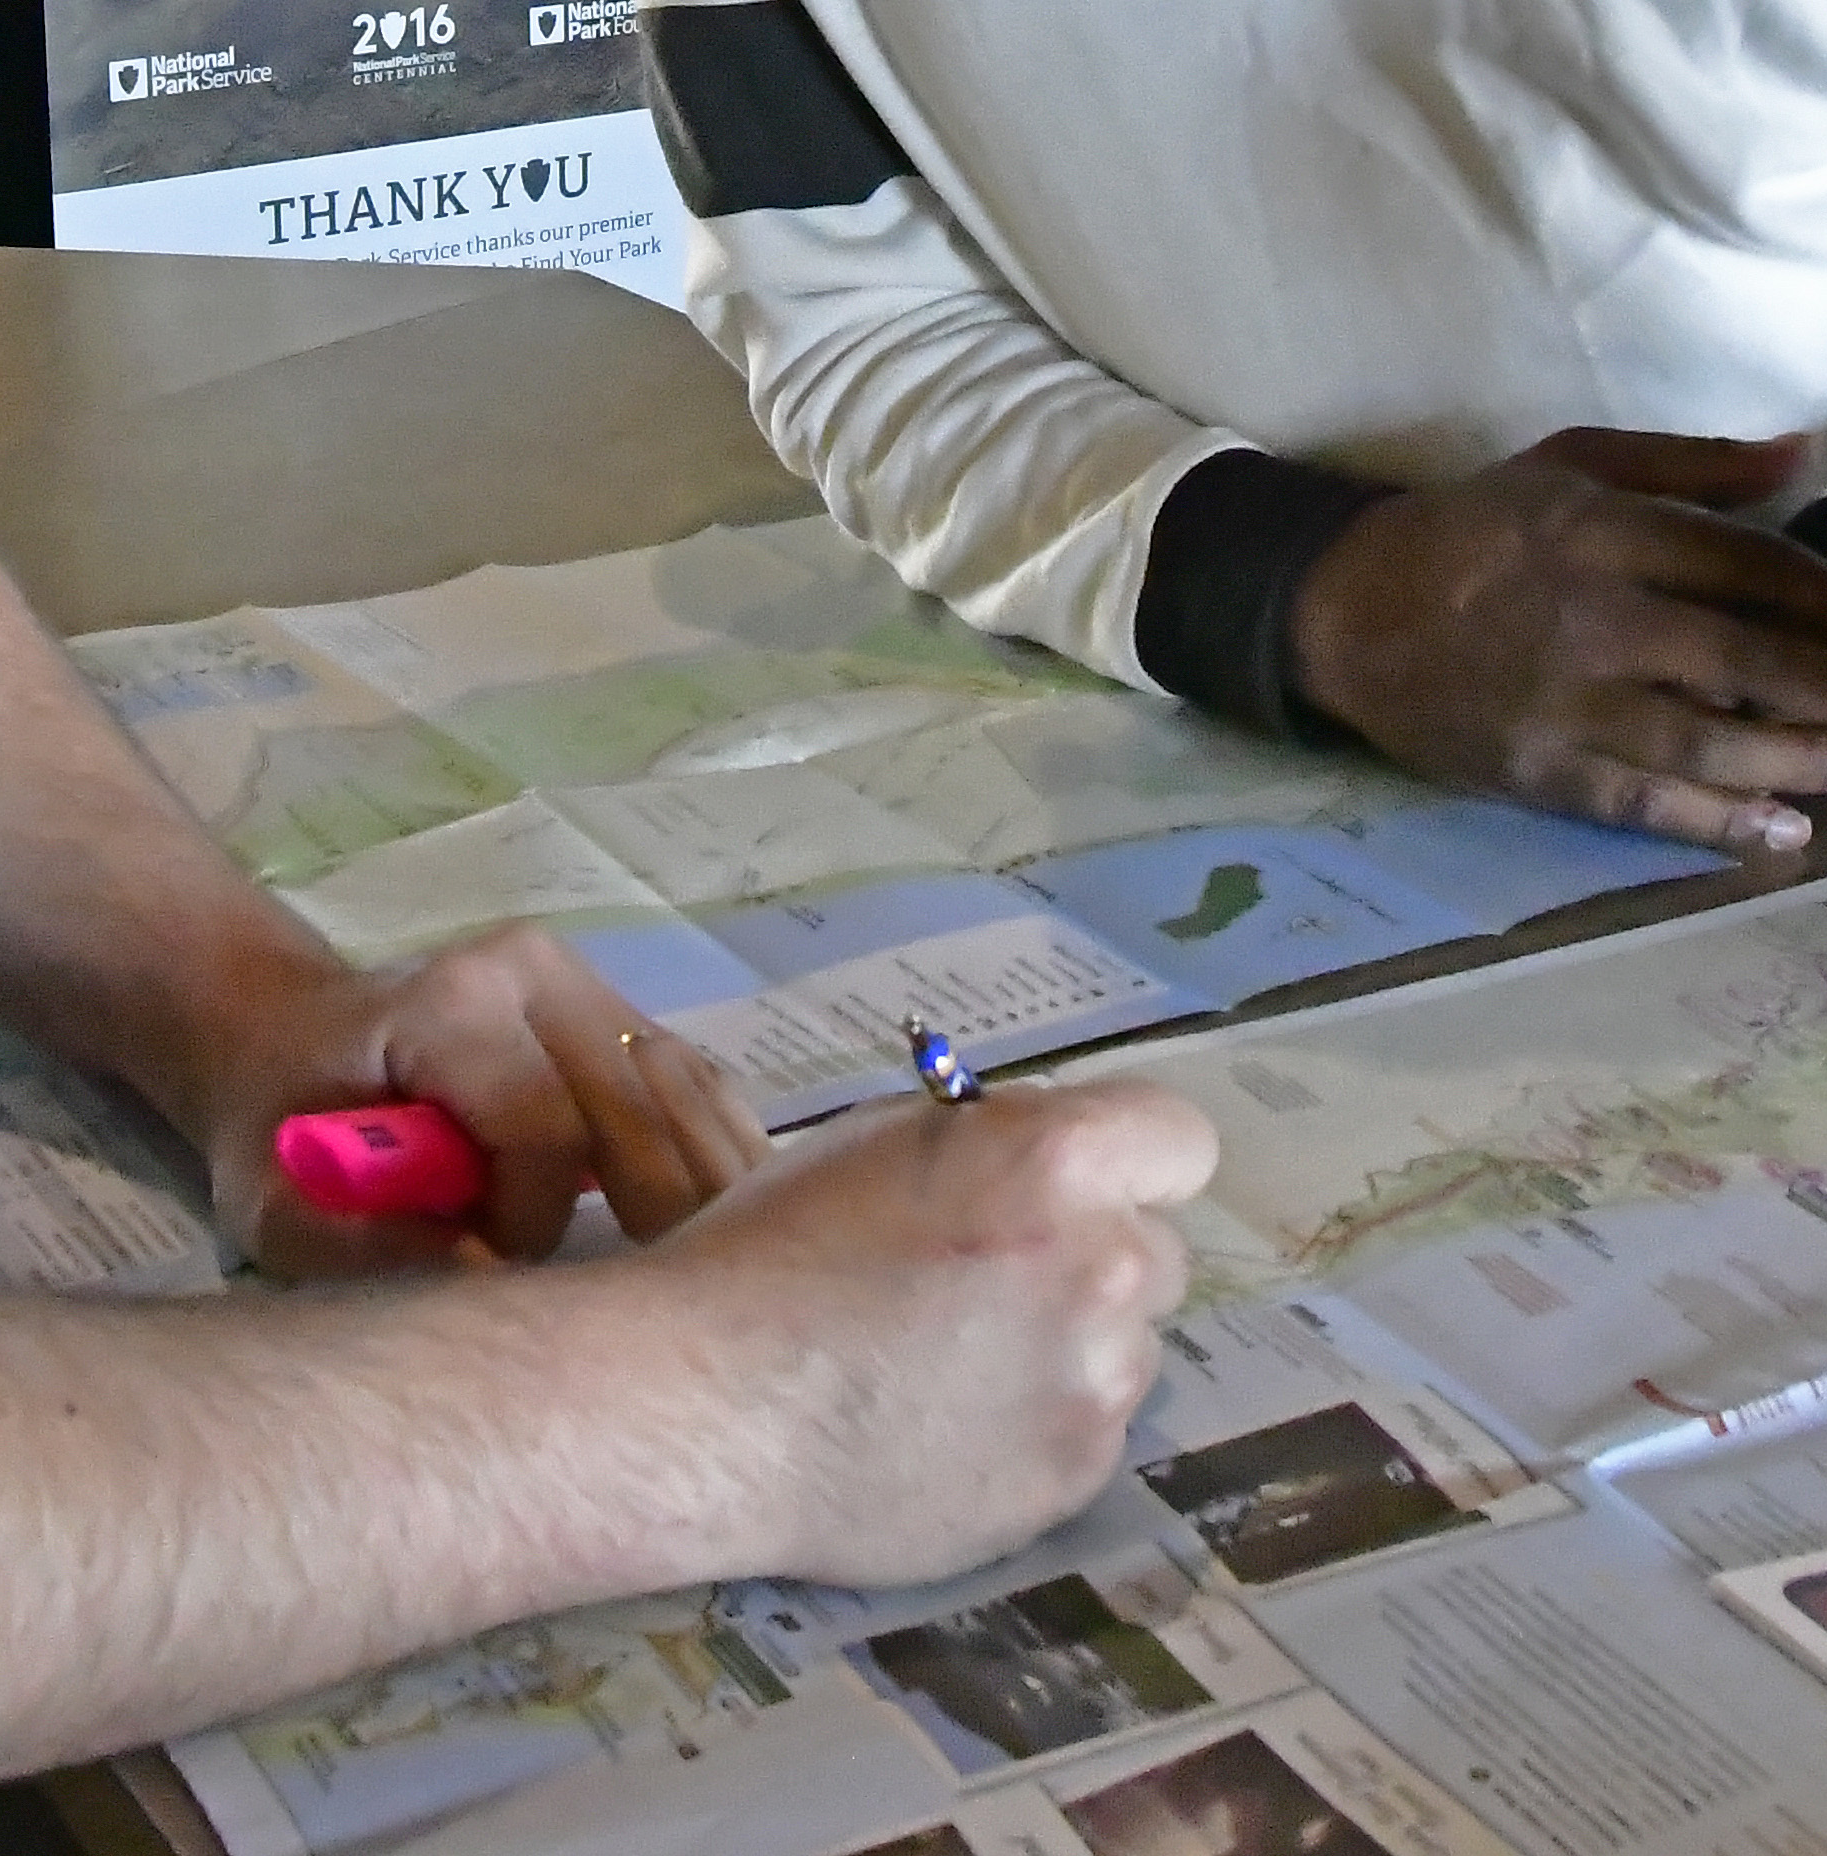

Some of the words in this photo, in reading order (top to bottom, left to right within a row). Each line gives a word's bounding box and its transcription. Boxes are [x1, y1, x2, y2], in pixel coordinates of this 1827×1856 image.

[150, 45, 235, 76] National
[352, 61, 457, 86] CENTENNIAL
[259, 170, 470, 245] THANK
[388, 241, 461, 265] Service
[466, 227, 535, 255] thanks
[539, 224, 574, 243] our
[578, 210, 654, 242] premier
[569, 248, 614, 267] Your
[619, 235, 662, 259] Park
